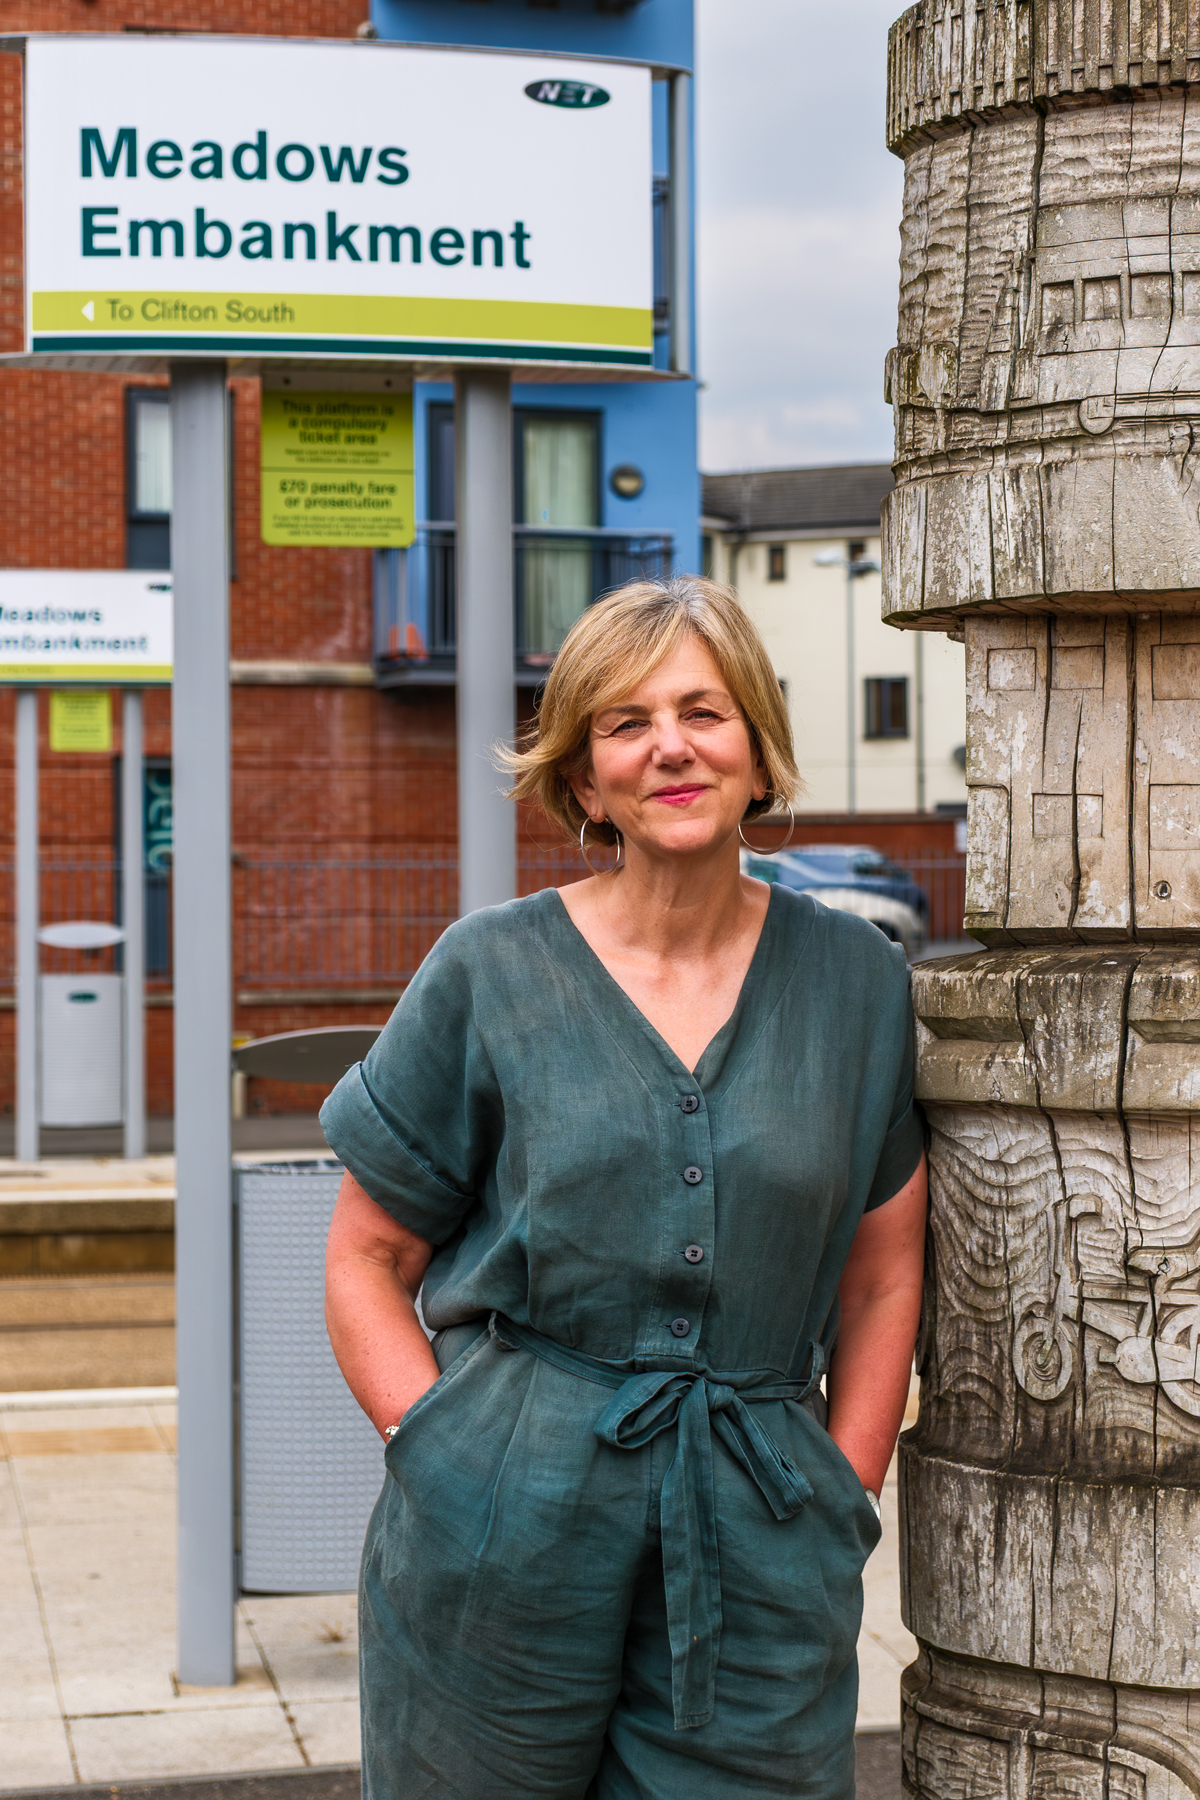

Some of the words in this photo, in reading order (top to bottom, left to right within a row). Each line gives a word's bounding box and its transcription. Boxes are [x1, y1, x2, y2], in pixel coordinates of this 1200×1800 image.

[536, 82, 601, 105] NET
[79, 127, 410, 186] Meadows
[80, 206, 532, 270] Embankment
[106, 298, 135, 322] To
[141, 298, 217, 322] Clifton
[225, 299, 295, 323] South
[282, 400, 312, 415] This
[316, 401, 378, 417] platform
[381, 406, 394, 416] is
[301, 417, 388, 432] compulsory
[299, 431, 340, 444] ticket
[344, 433, 377, 445] area
[279, 479, 307, 493] £70
[311, 481, 364, 495] penalty
[368, 481, 397, 494] fare
[285, 497, 300, 508] or
[304, 497, 392, 510] prosecution
[0, 636, 147, 653] mbankment
